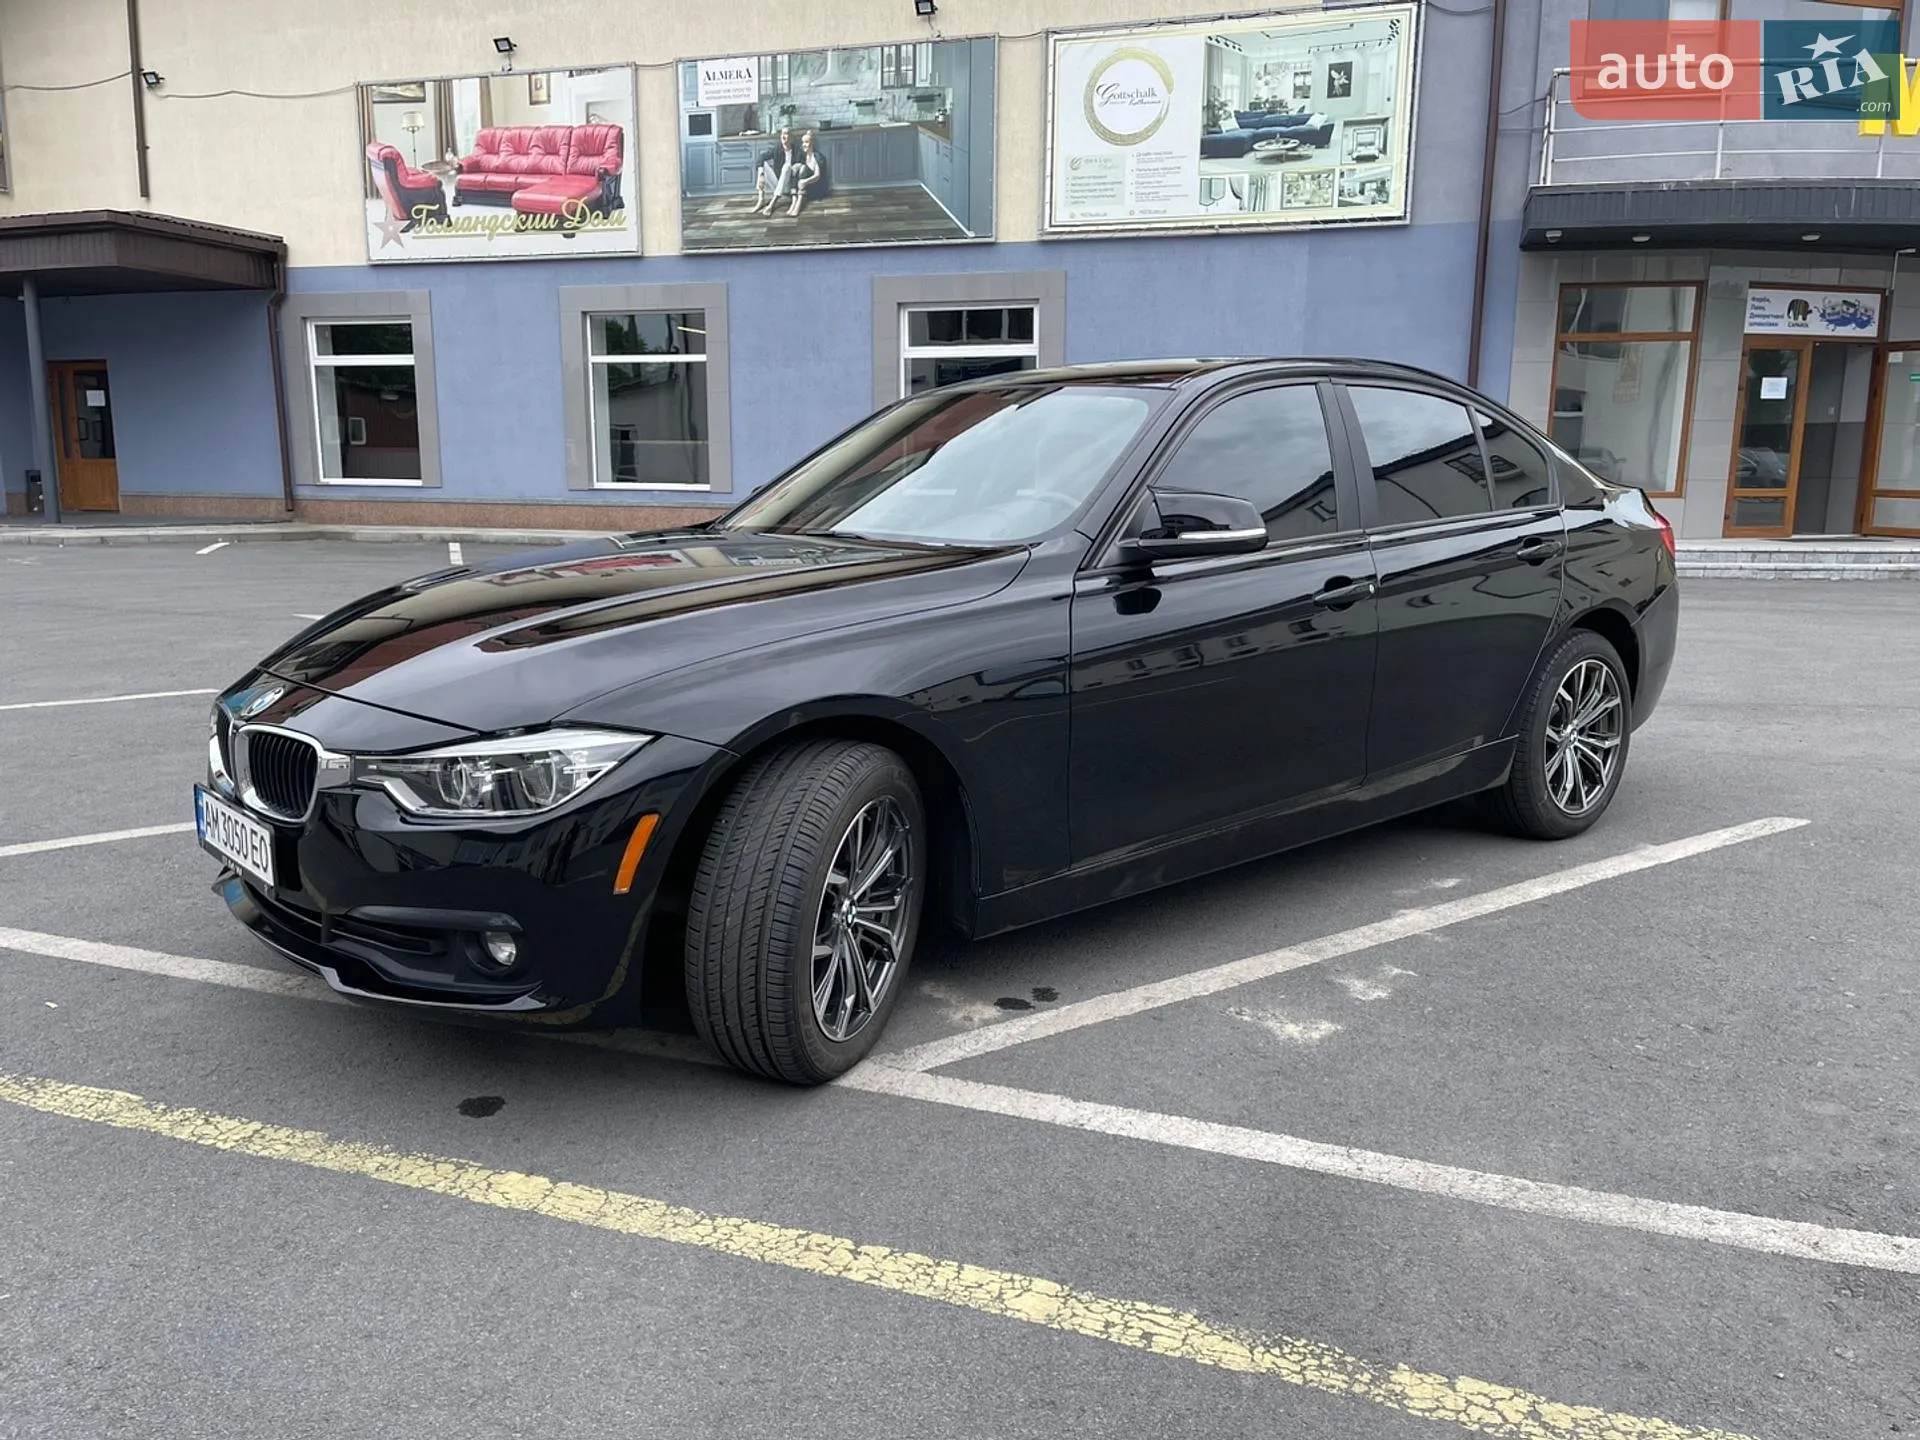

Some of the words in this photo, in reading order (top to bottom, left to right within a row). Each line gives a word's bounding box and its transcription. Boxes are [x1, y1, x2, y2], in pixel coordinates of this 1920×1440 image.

[561, 196, 625, 230] Дом
[205, 801, 220, 843] AM
[221, 810, 249, 860] 3050
[250, 828, 269, 873] EO
